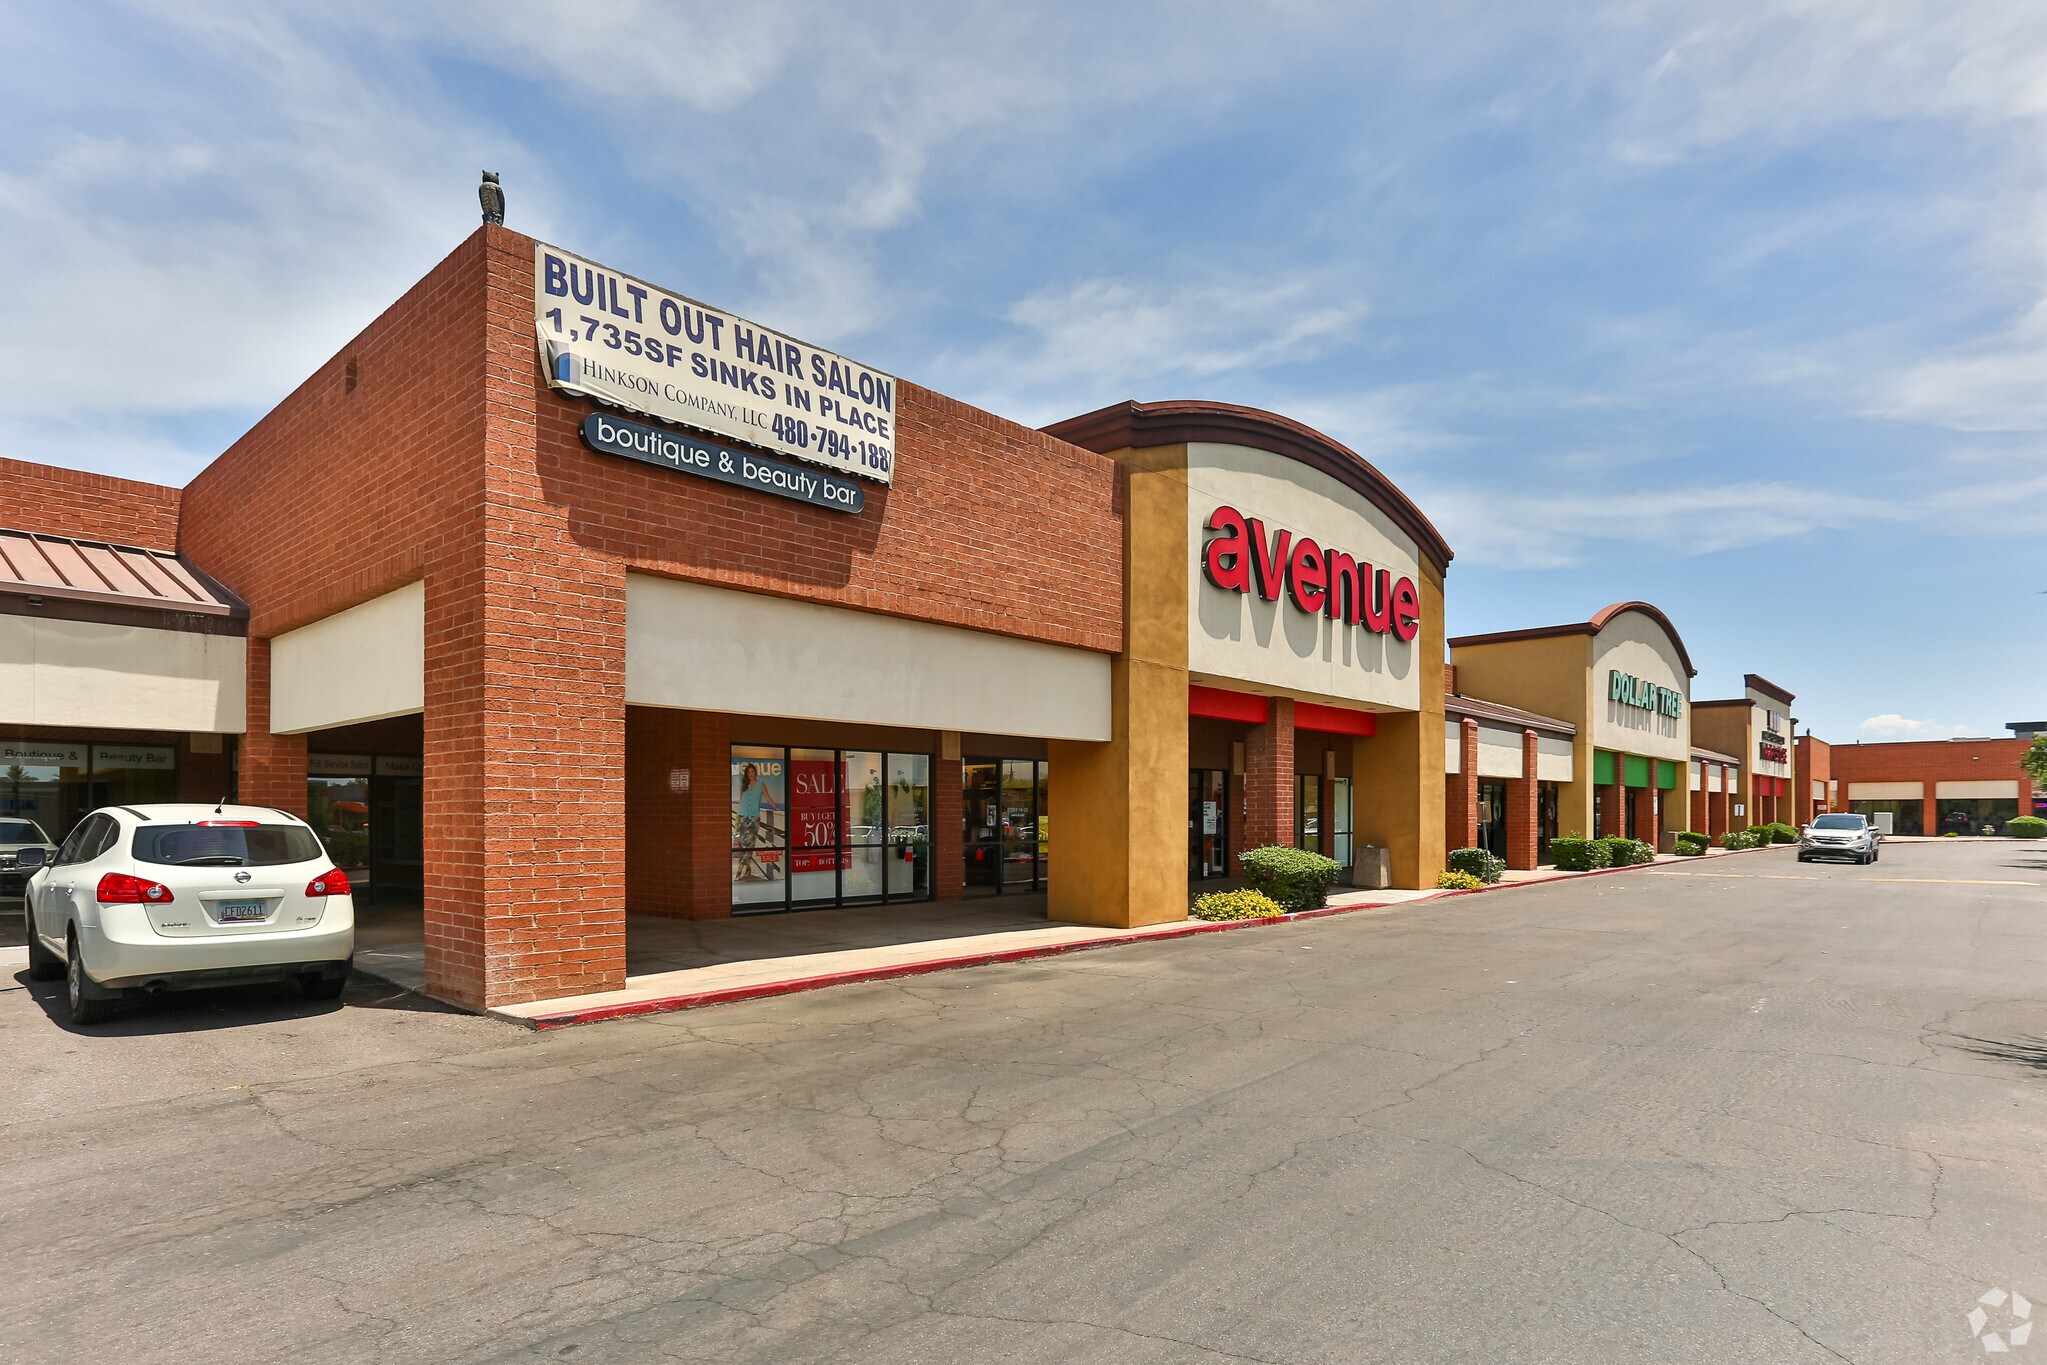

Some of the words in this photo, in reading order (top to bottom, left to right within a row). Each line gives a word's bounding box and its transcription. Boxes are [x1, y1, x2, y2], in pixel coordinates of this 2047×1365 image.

[545, 253, 647, 324] BUILT
[659, 298, 724, 351] OUT
[734, 324, 804, 380] HAIR
[811, 353, 891, 413] SALON
[546, 307, 682, 368] 1,735SF
[691, 352, 776, 400] SINKS
[785, 383, 811, 412] IN
[819, 395, 890, 440] PLACE
[582, 357, 659, 397] HINKSON
[742, 407, 768, 430] LLC
[597, 417, 710, 467] boutique
[719, 450, 735, 475] &
[743, 457, 818, 499] beauty
[824, 479, 856, 505] bar
[1202, 505, 1419, 642] avenue
[1609, 670, 1657, 711] DOLLAR
[1658, 687, 1682, 719] TREE
[5, 748, 64, 762] Boutique
[69, 751, 78, 761] &
[100, 752, 143, 764] Beauty
[146, 753, 168, 763] Bar
[800, 812, 815, 821] BUY
[224, 905, 262, 917] CFD2611
